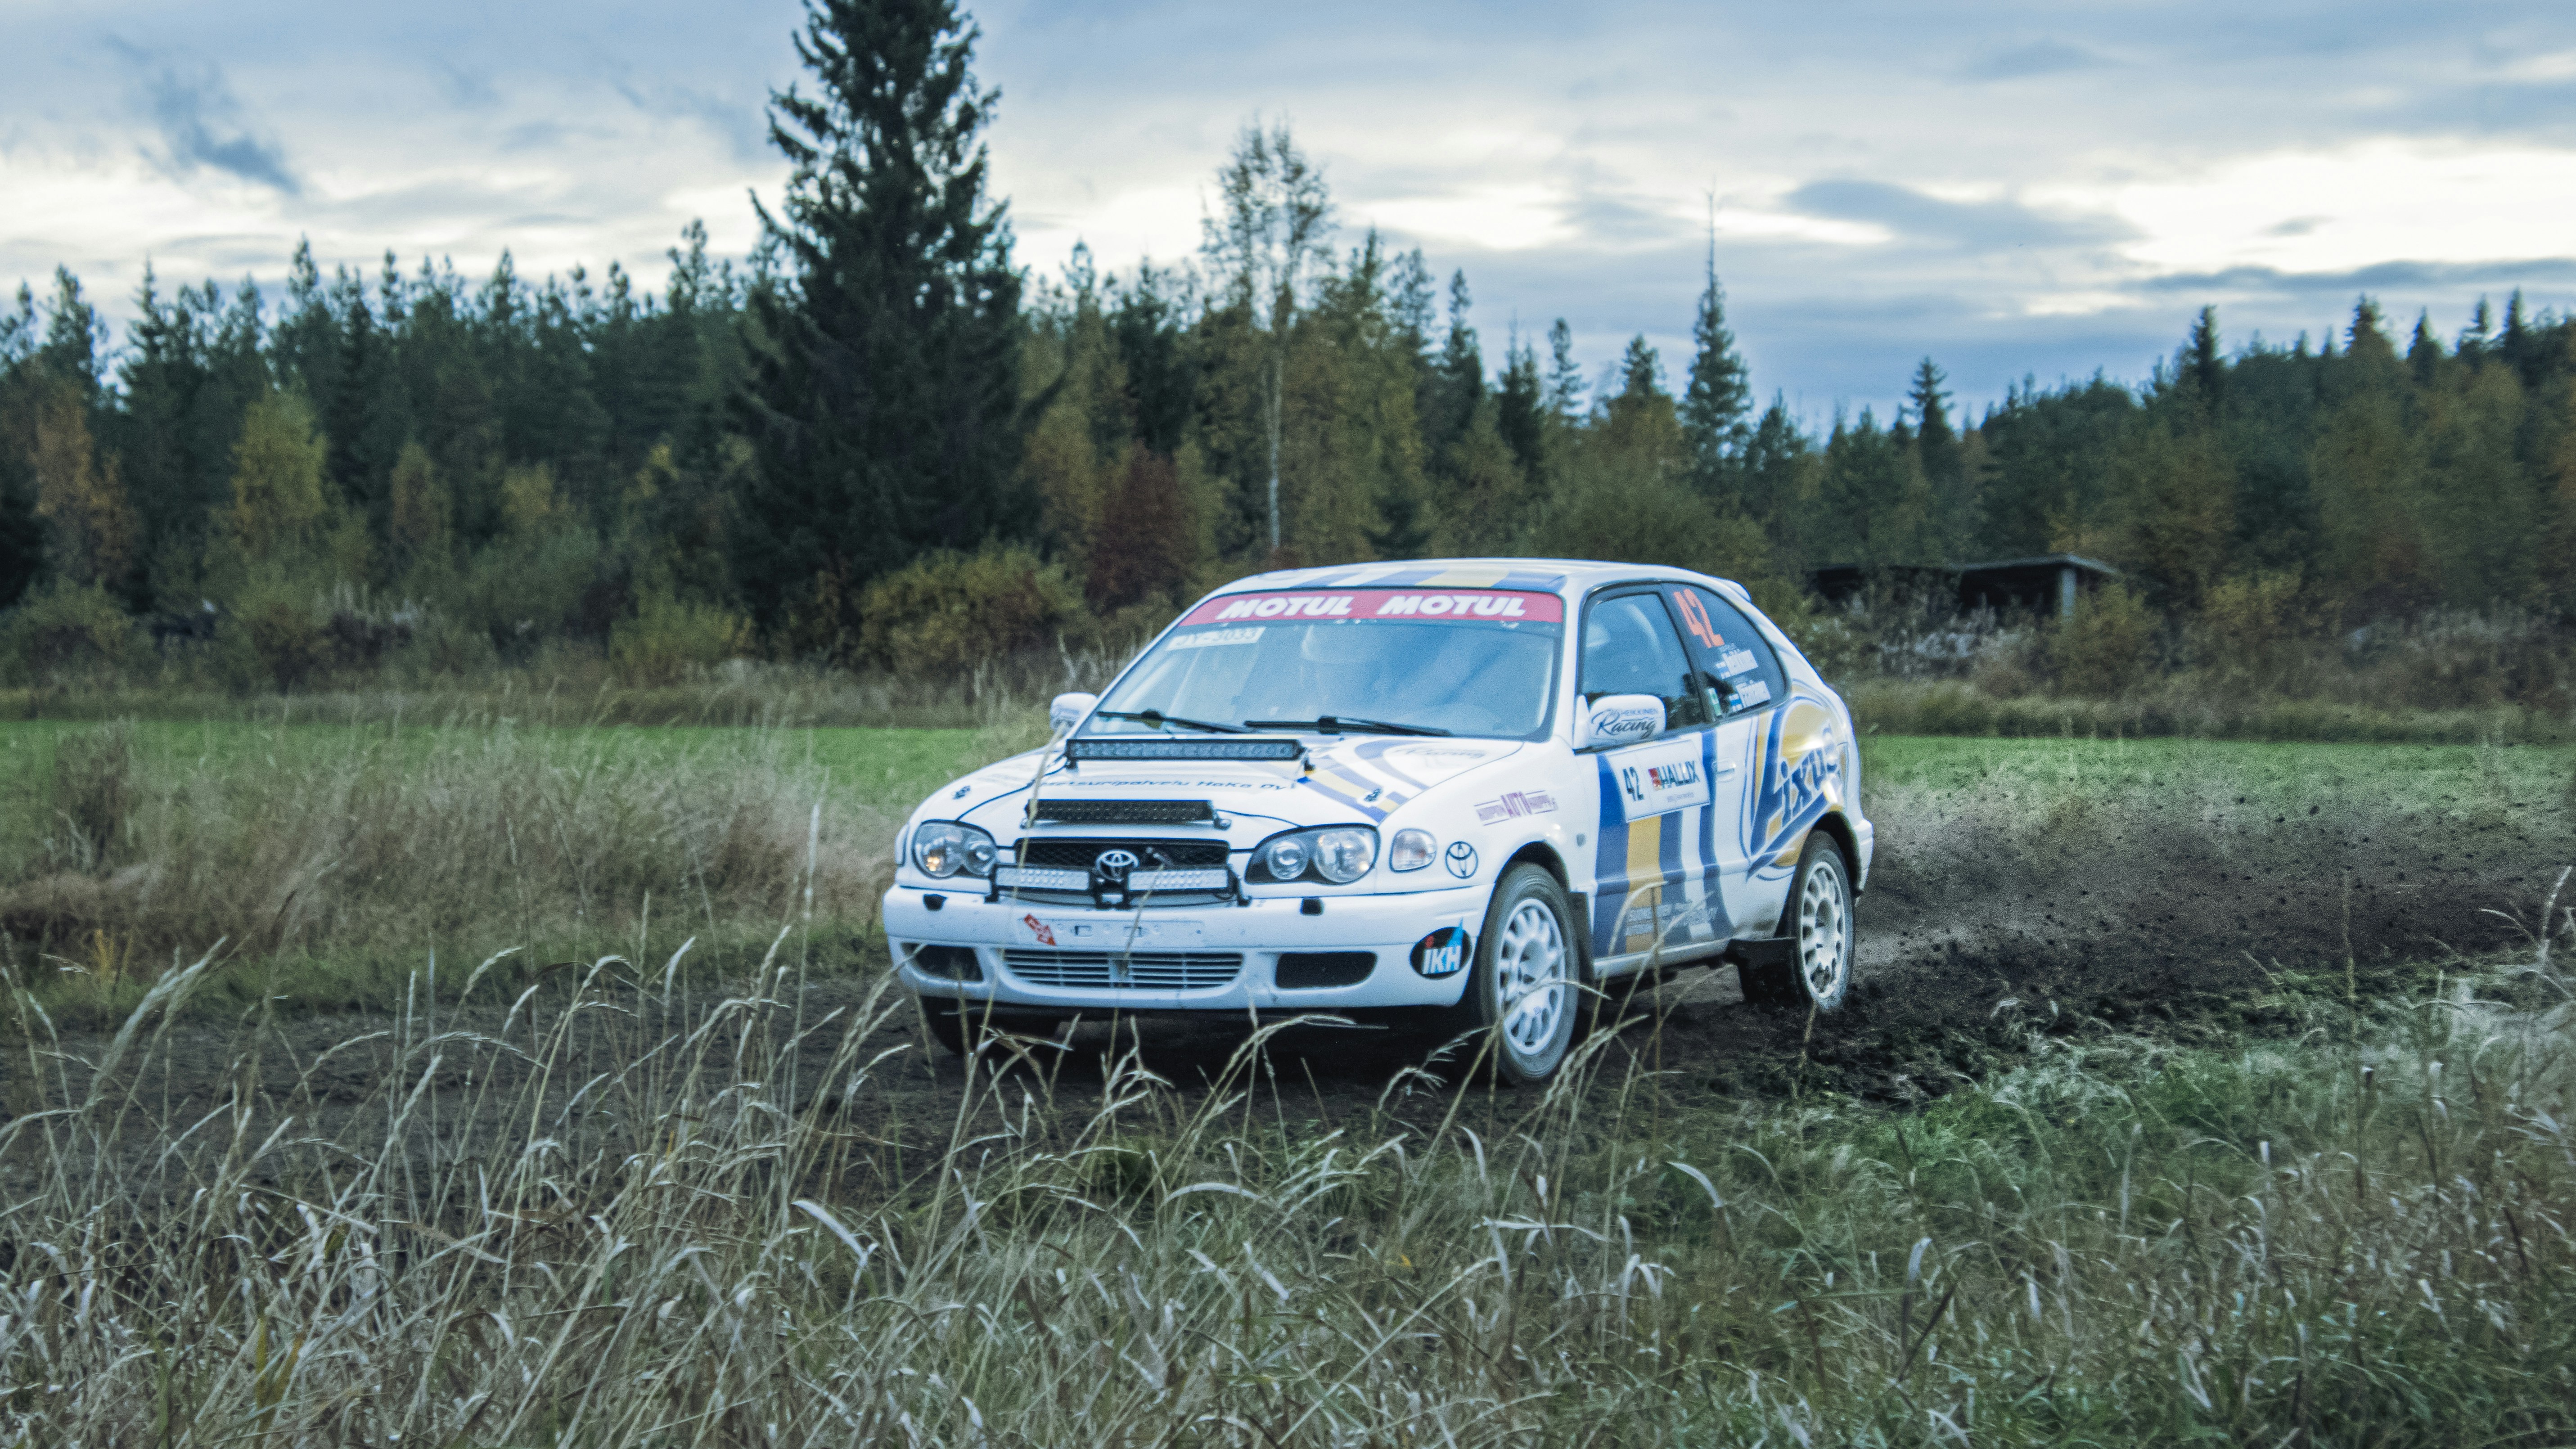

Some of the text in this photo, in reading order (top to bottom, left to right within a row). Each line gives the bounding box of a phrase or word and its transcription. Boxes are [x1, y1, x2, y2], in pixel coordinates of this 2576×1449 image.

[1216, 595, 1526, 620] MOTUL MOTUL
[1673, 588, 1725, 648] 42
[1591, 707, 1657, 740] Racing
[1622, 766, 1645, 801] 42
[1422, 944, 1462, 975] IKH
